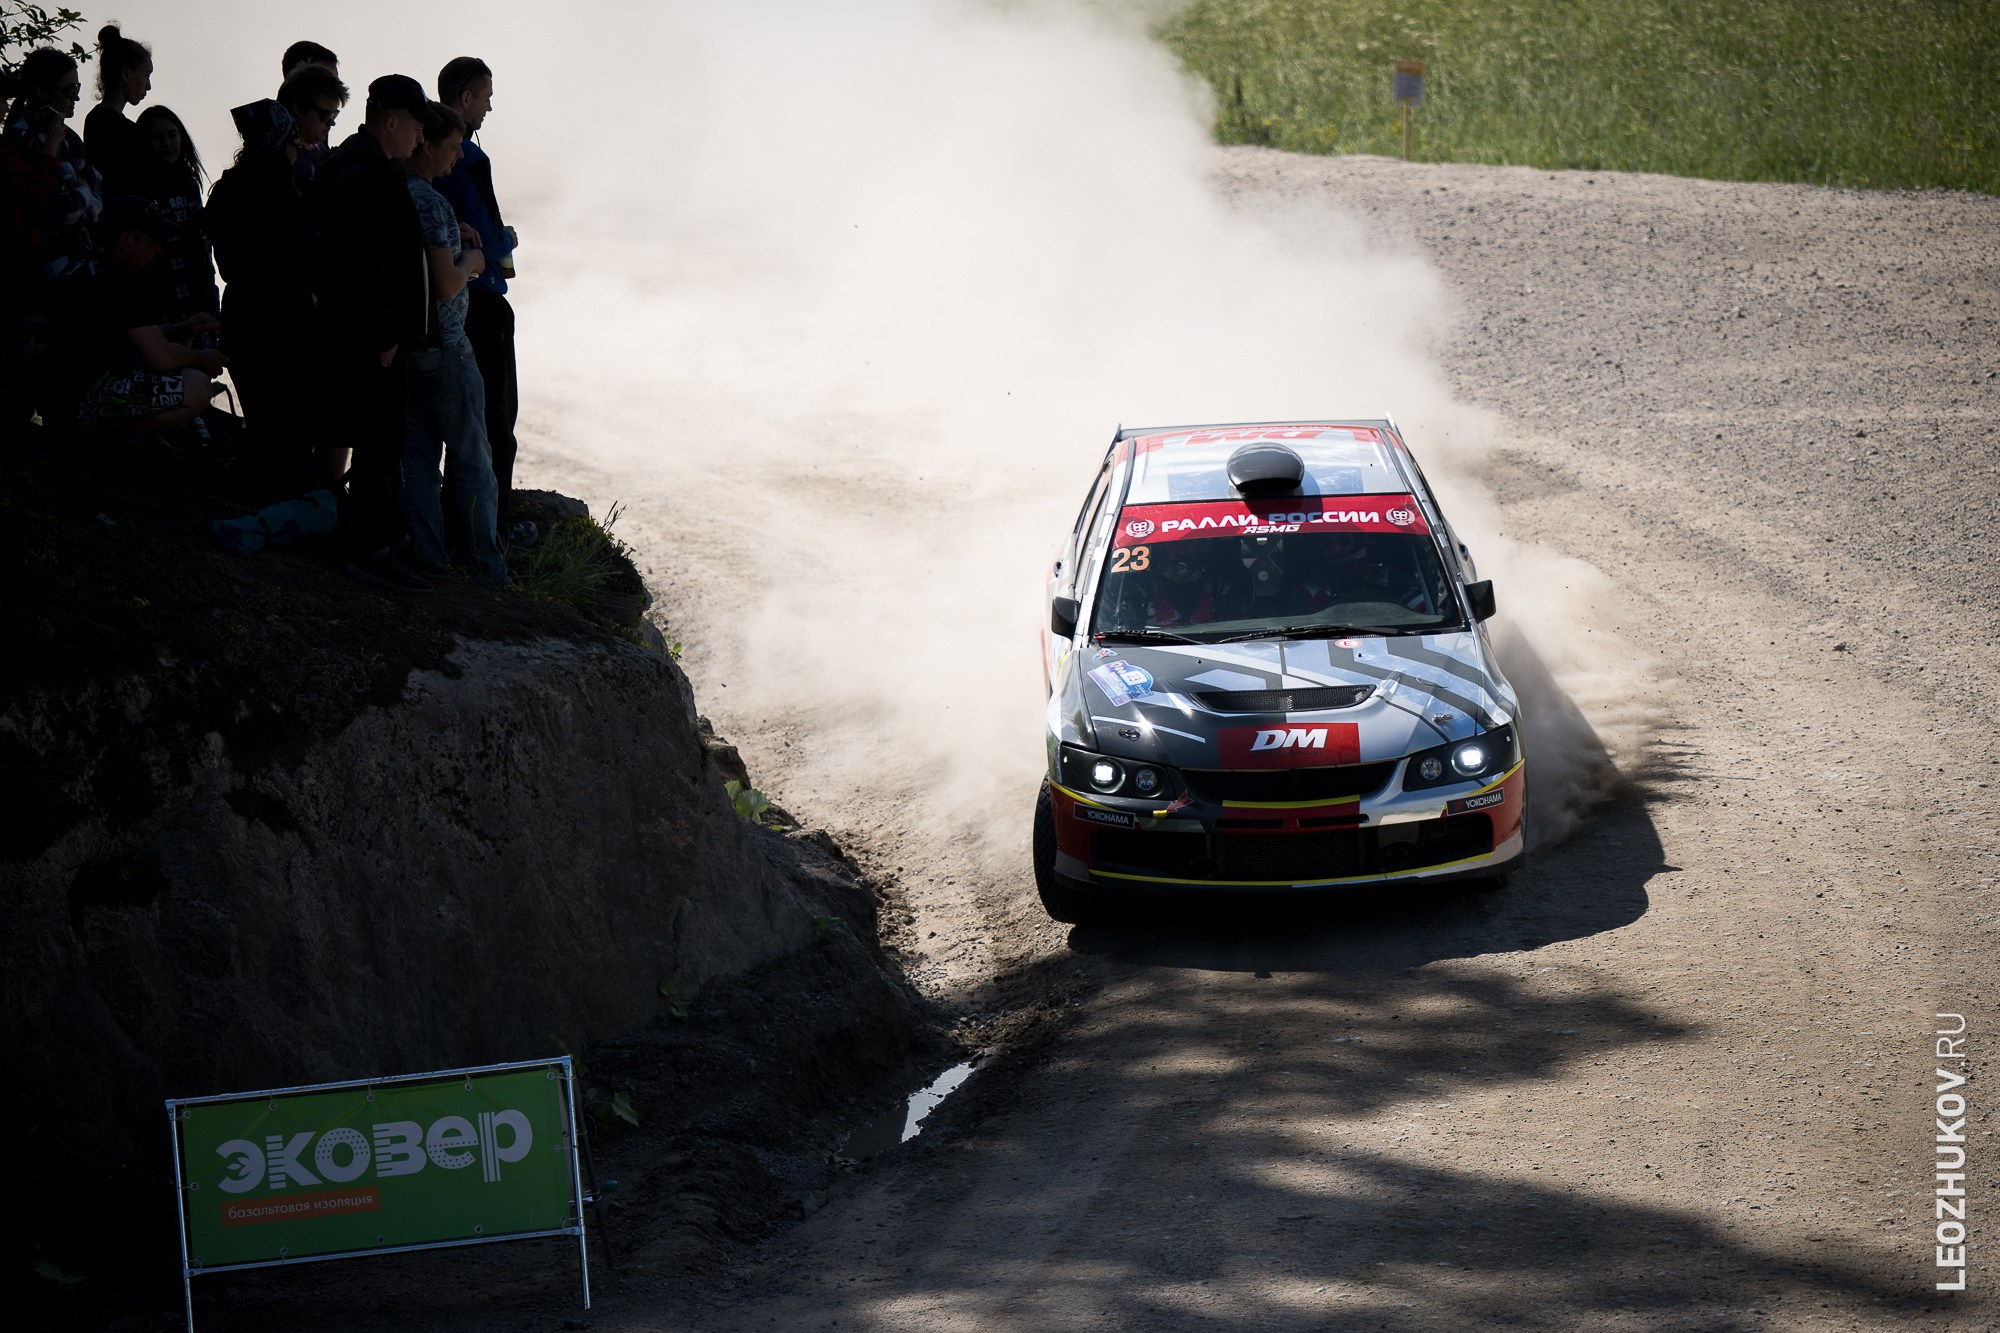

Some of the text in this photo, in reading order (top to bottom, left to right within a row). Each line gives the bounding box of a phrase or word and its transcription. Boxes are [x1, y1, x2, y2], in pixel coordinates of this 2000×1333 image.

[1161, 510, 1380, 533] РАЛЛИ РОССИИ
[1110, 545, 1150, 574] 23
[1249, 728, 1329, 752] DM
[1465, 792, 1503, 809] YOKOHAMA
[1086, 809, 1130, 825] YOKOHAMA
[228, 1194, 374, 1220] базальтовая изоляция
